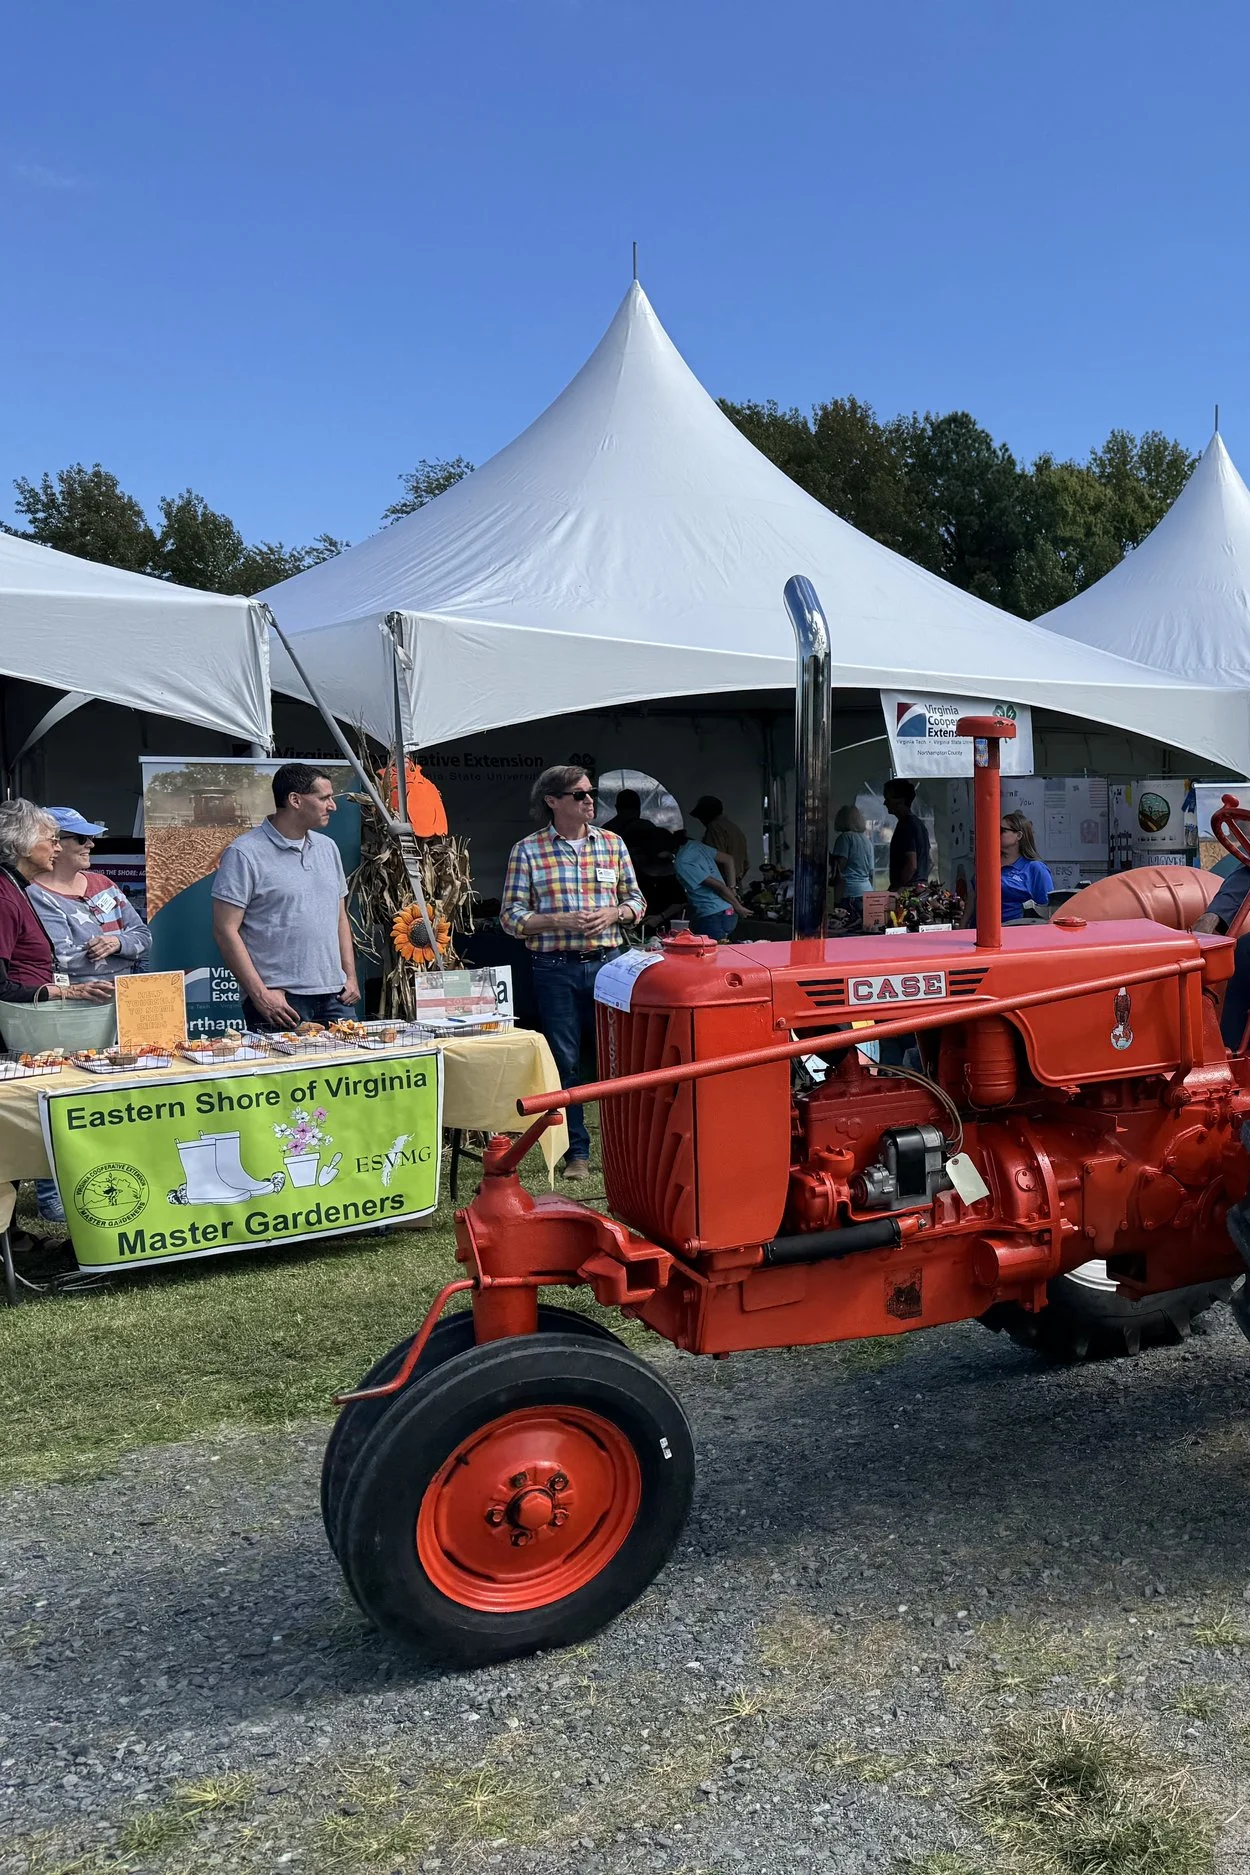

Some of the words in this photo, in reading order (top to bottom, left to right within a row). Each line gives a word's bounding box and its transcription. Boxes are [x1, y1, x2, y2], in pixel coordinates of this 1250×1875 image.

[925, 704, 959, 717] Virginia
[928, 716, 957, 728] Coope
[928, 728, 957, 738] Extens
[464, 753, 544, 768] Extension
[853, 974, 943, 1001] CASE
[67, 1099, 186, 1131] Eastern
[196, 1090, 281, 1114] Shore
[290, 1080, 318, 1104] of
[325, 1069, 427, 1099] Virginia
[356, 1146, 431, 1173] ESVMG
[89, 1164, 125, 1178] COOPERATIVE
[80, 1210, 107, 1227] MASTER
[118, 1220, 233, 1256] Master
[245, 1193, 405, 1236] Gardeners
